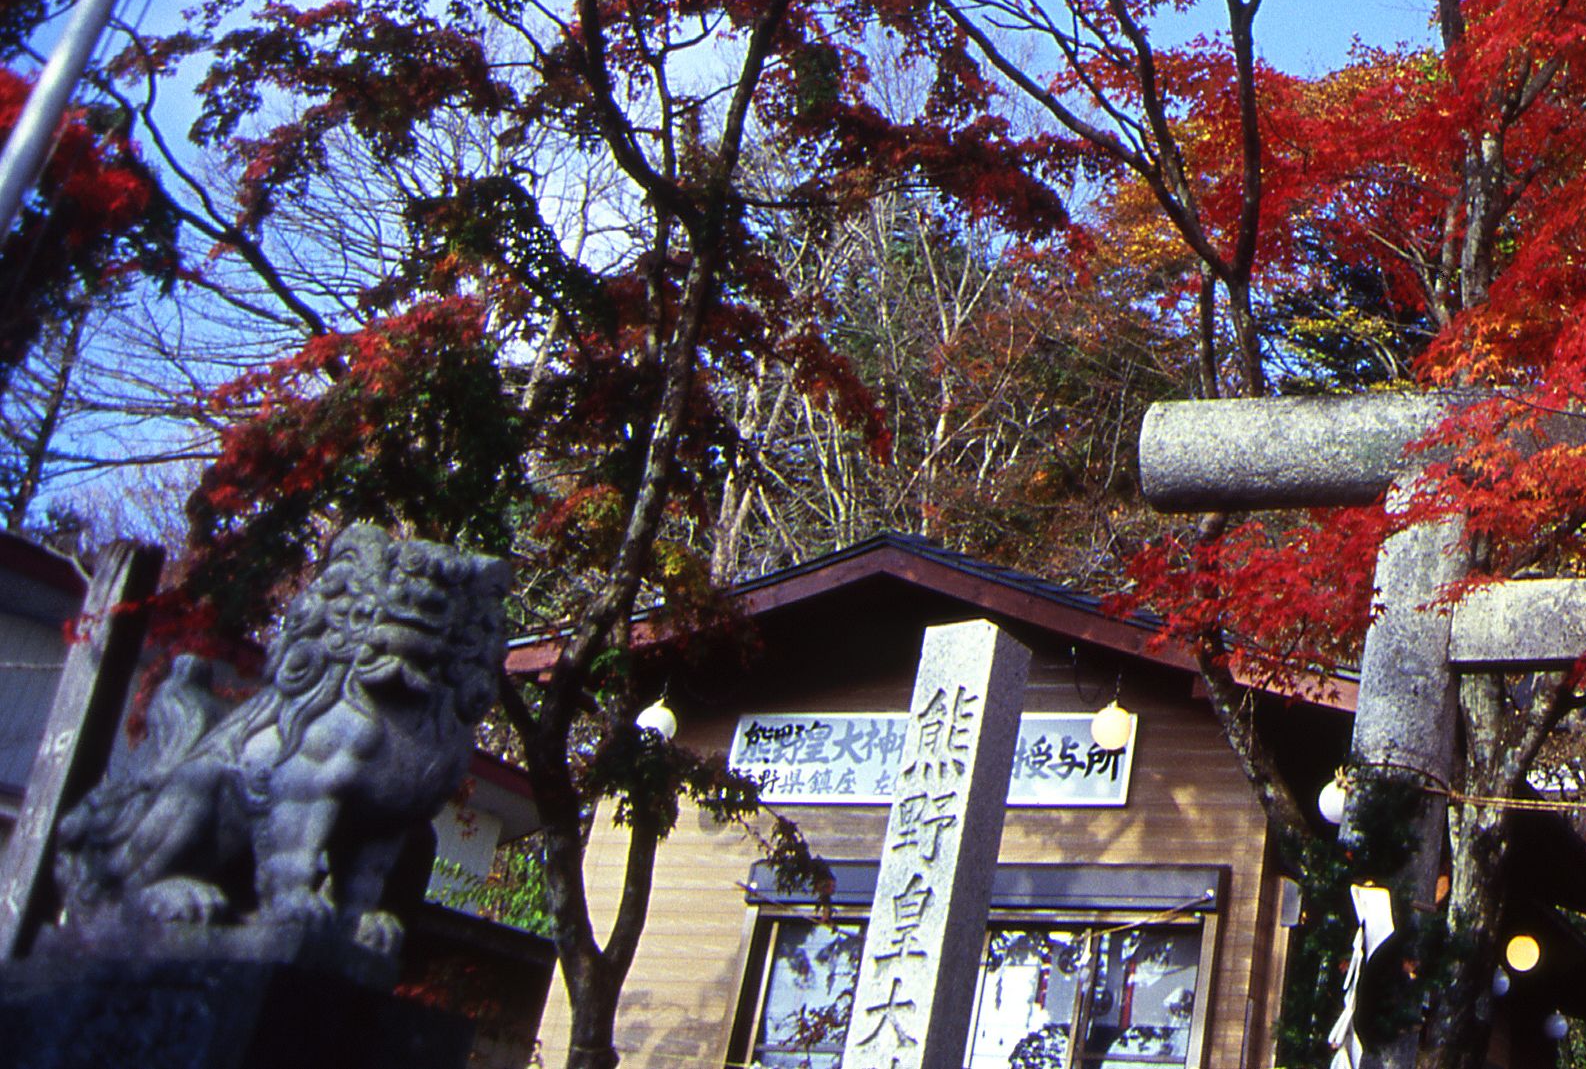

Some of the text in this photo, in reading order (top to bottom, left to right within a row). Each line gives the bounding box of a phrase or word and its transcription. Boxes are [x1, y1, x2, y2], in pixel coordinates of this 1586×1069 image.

[733, 768, 857, 797] 野県鎮座
[856, 685, 979, 1069] 熊野皇大
